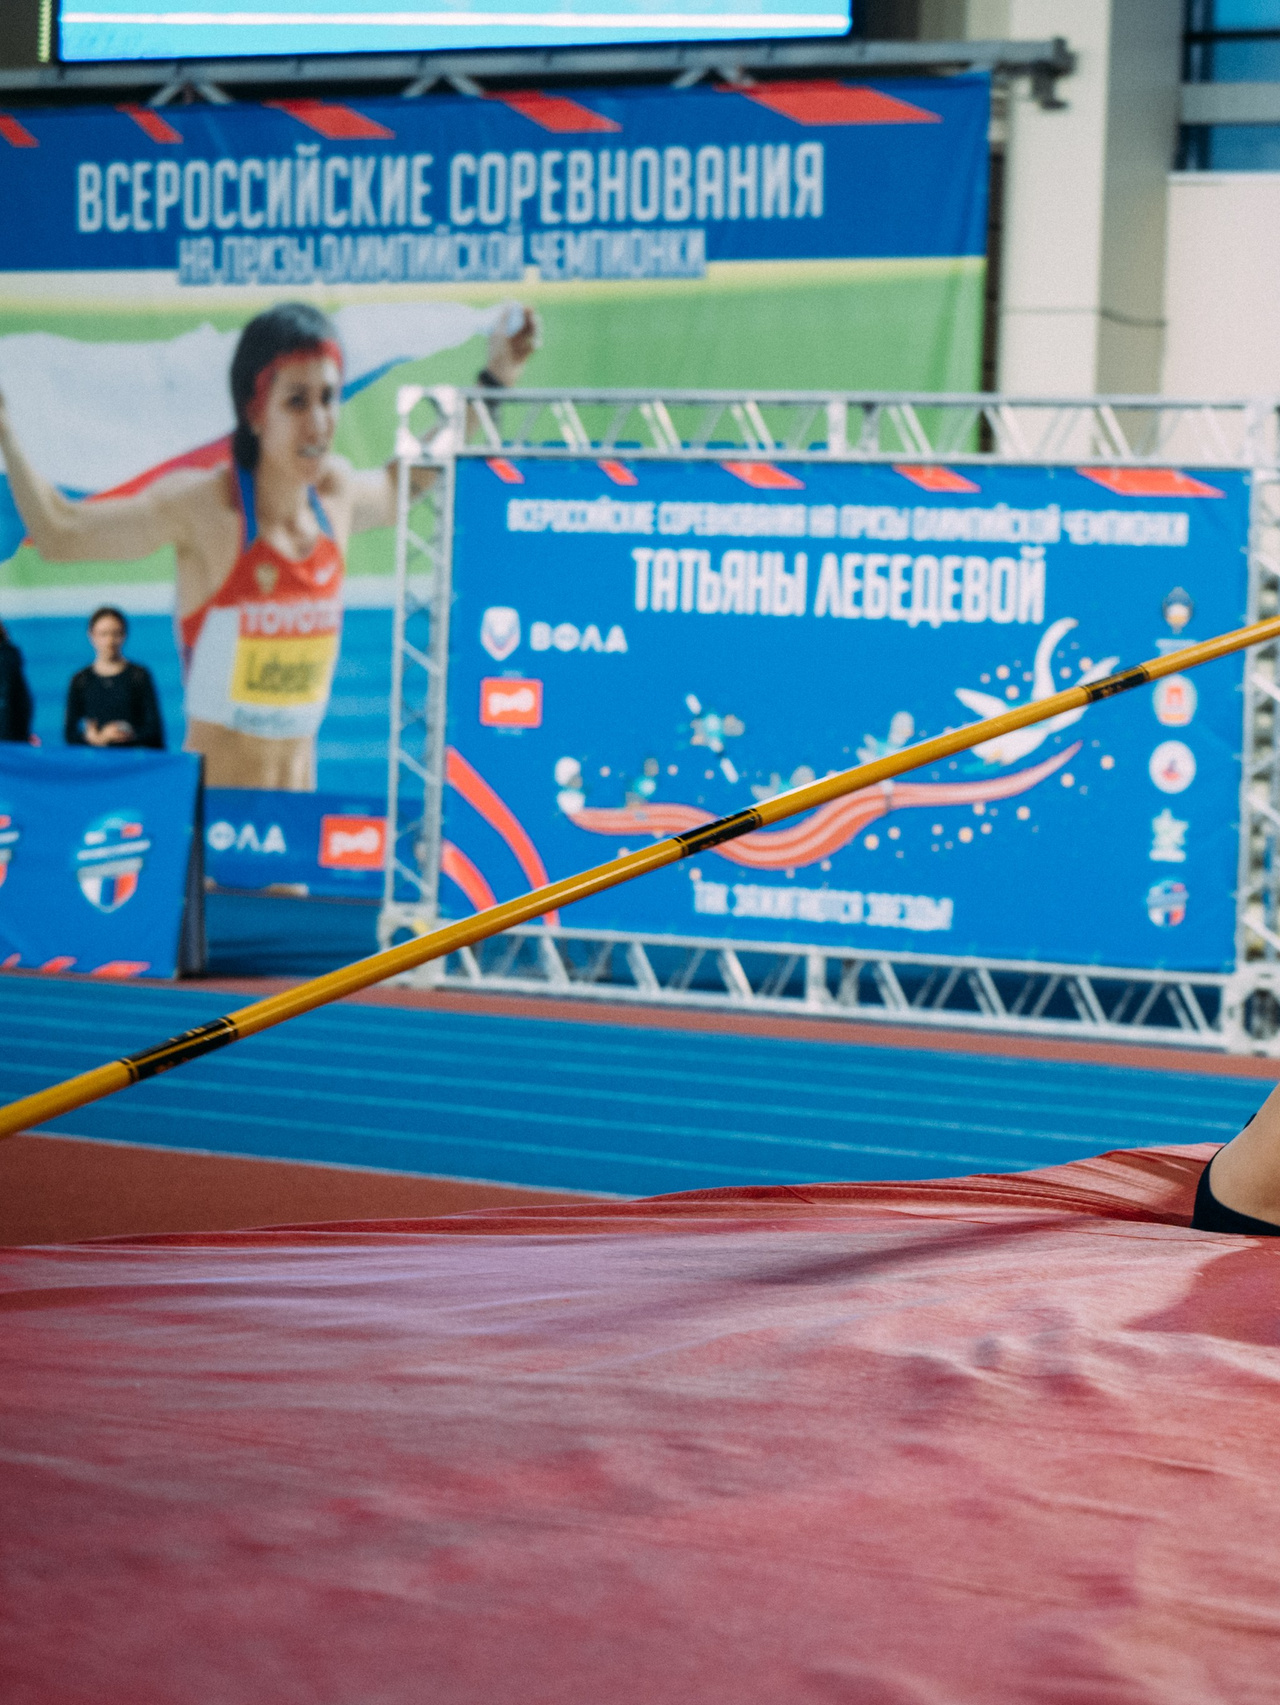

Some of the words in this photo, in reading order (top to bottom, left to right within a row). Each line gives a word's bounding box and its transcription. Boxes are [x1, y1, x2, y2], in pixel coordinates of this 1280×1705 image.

[78, 144, 434, 232] ВСЕРОССИЙСКИЕ
[450, 142, 824, 225] СОРЕВНОВАНИЯ
[631, 547, 808, 617] ТАТЬЯНЫ
[813, 546, 1046, 629] ЛЕБЕДЕВОЙ
[207, 820, 287, 855] ФЛА
